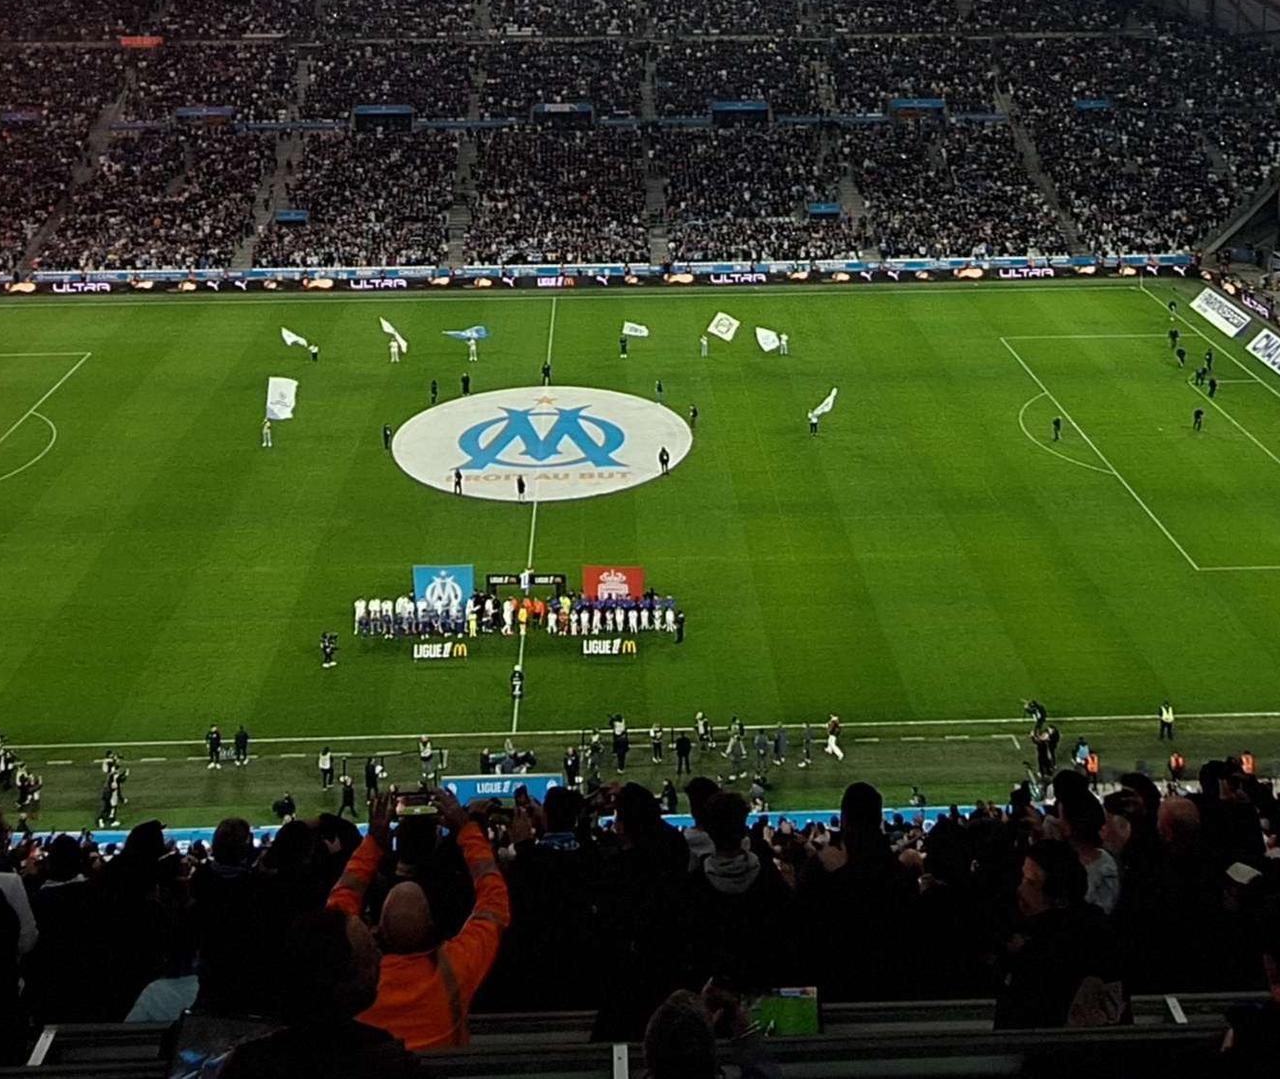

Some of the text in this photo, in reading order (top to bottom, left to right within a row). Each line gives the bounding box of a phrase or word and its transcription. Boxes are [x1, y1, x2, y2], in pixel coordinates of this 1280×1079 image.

[710, 273, 767, 283] ULTRA
[999, 268, 1055, 278] ULTRA
[52, 283, 111, 293] ULTRA
[350, 278, 408, 288] ULTRA
[1242, 294, 1269, 319] ULTRA
[534, 472, 570, 481] AU
[579, 471, 632, 480] BUT
[413, 643, 443, 659] LIGUE
[583, 640, 613, 655] LIGUE
[476, 781, 503, 795] LIGUE
